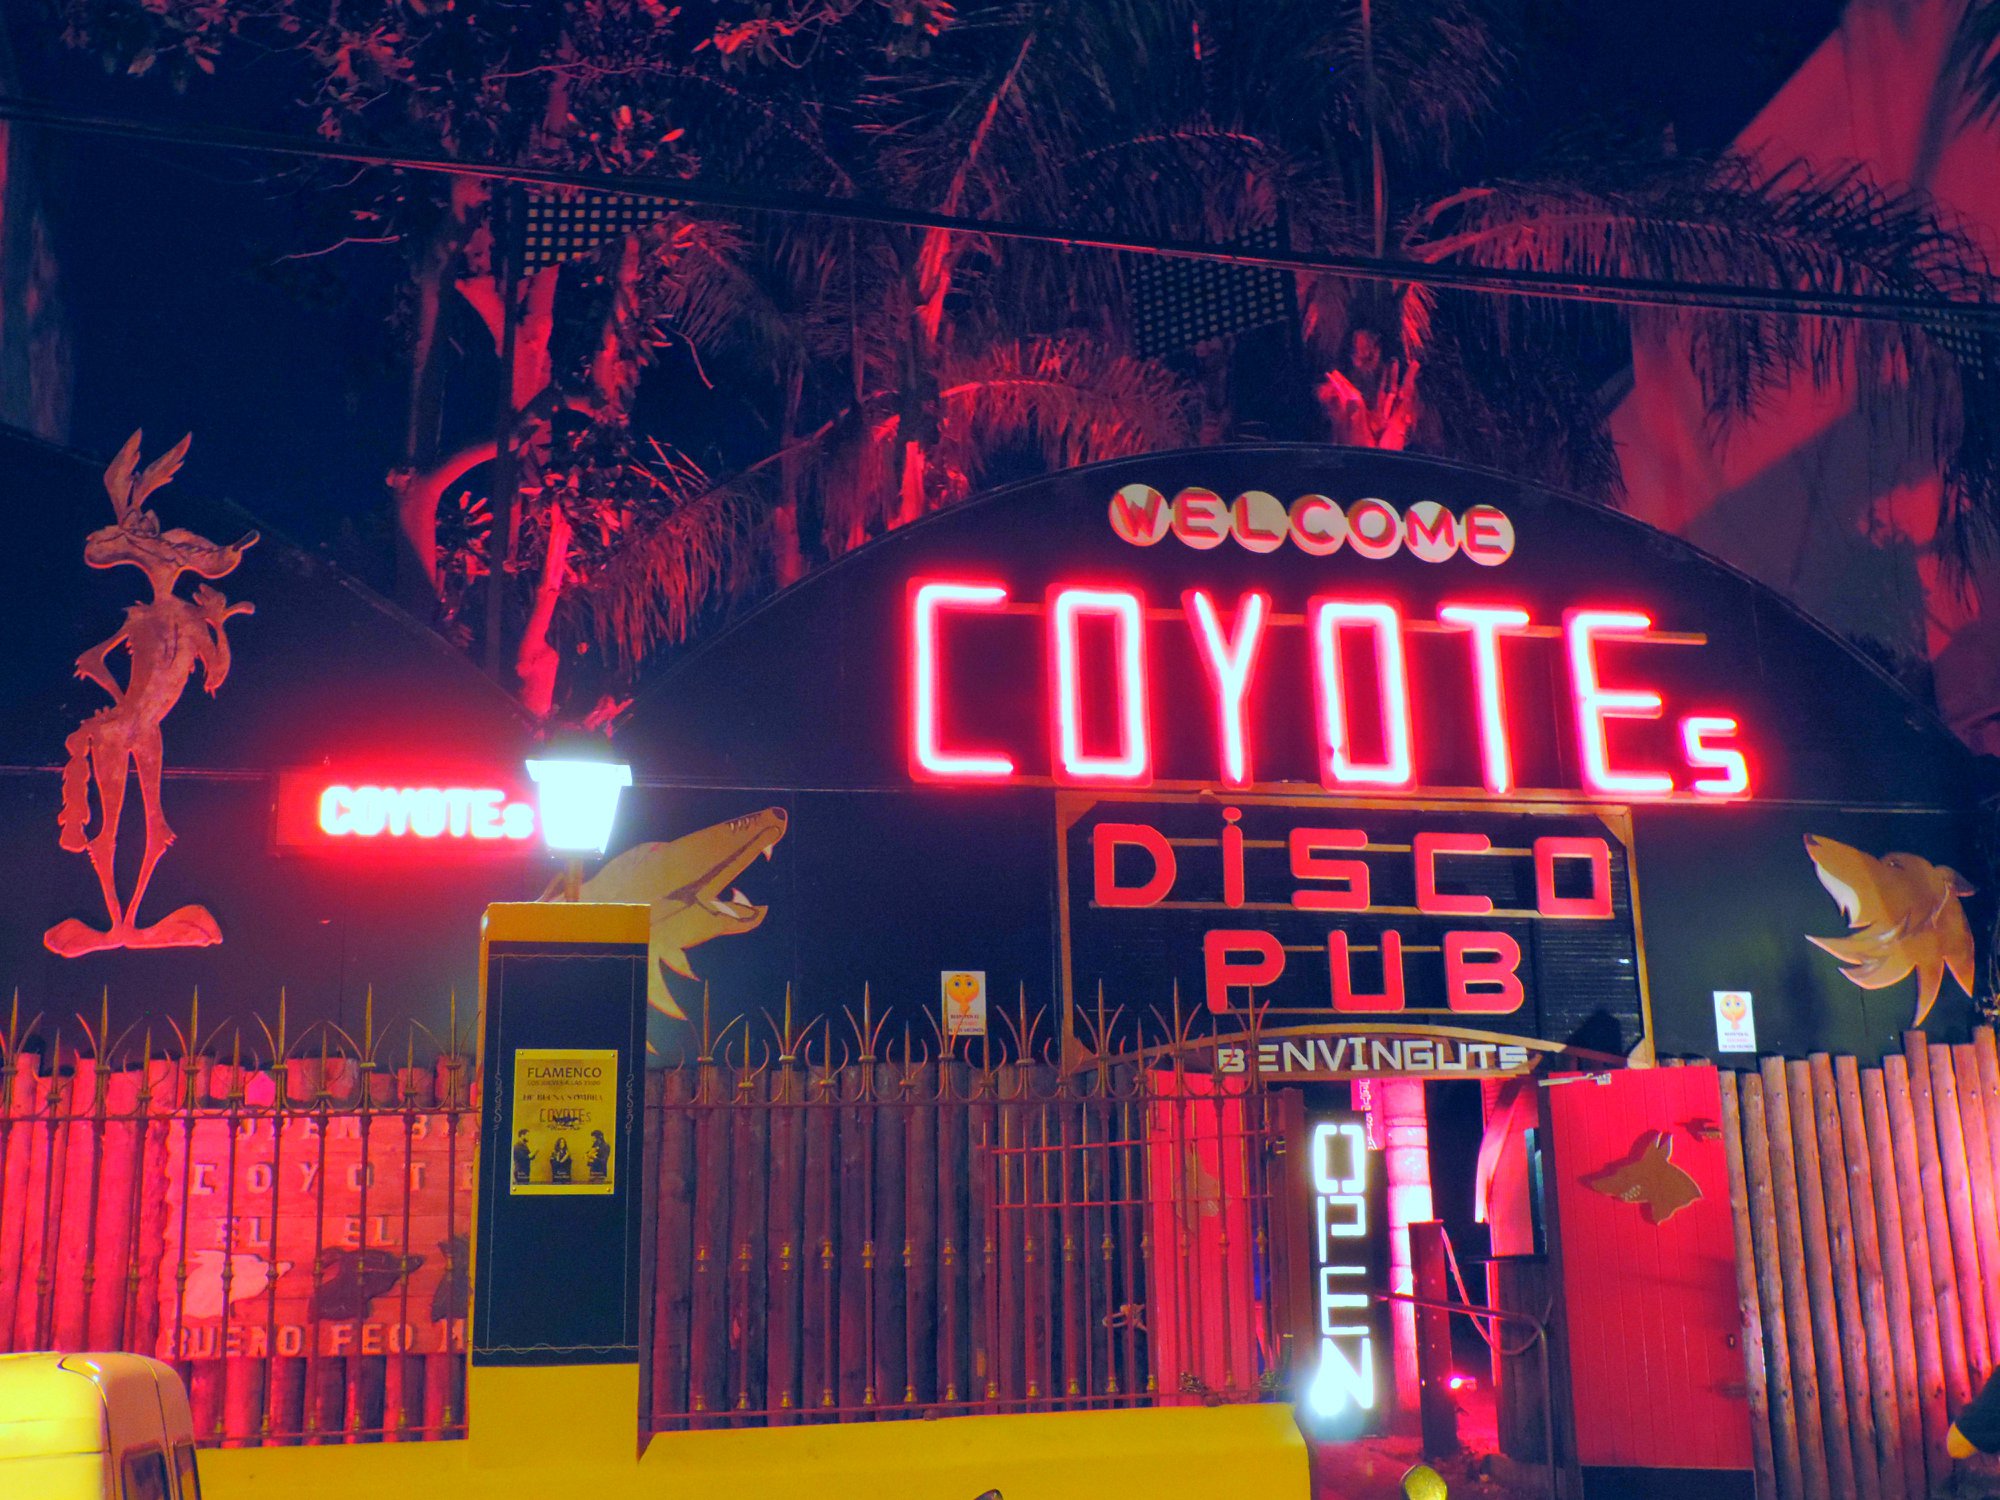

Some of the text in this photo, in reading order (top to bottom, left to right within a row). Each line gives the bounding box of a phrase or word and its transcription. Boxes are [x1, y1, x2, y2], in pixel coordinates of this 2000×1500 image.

[1111, 486, 1509, 556] WELCOME
[1203, 929, 1524, 1014] PUB
[527, 1067, 602, 1078] FLAMENCO
[1217, 1036, 1529, 1073] BENVINGUTS
[1313, 1124, 1374, 1409] OPEN
[331, 1322, 415, 1355] FEO
